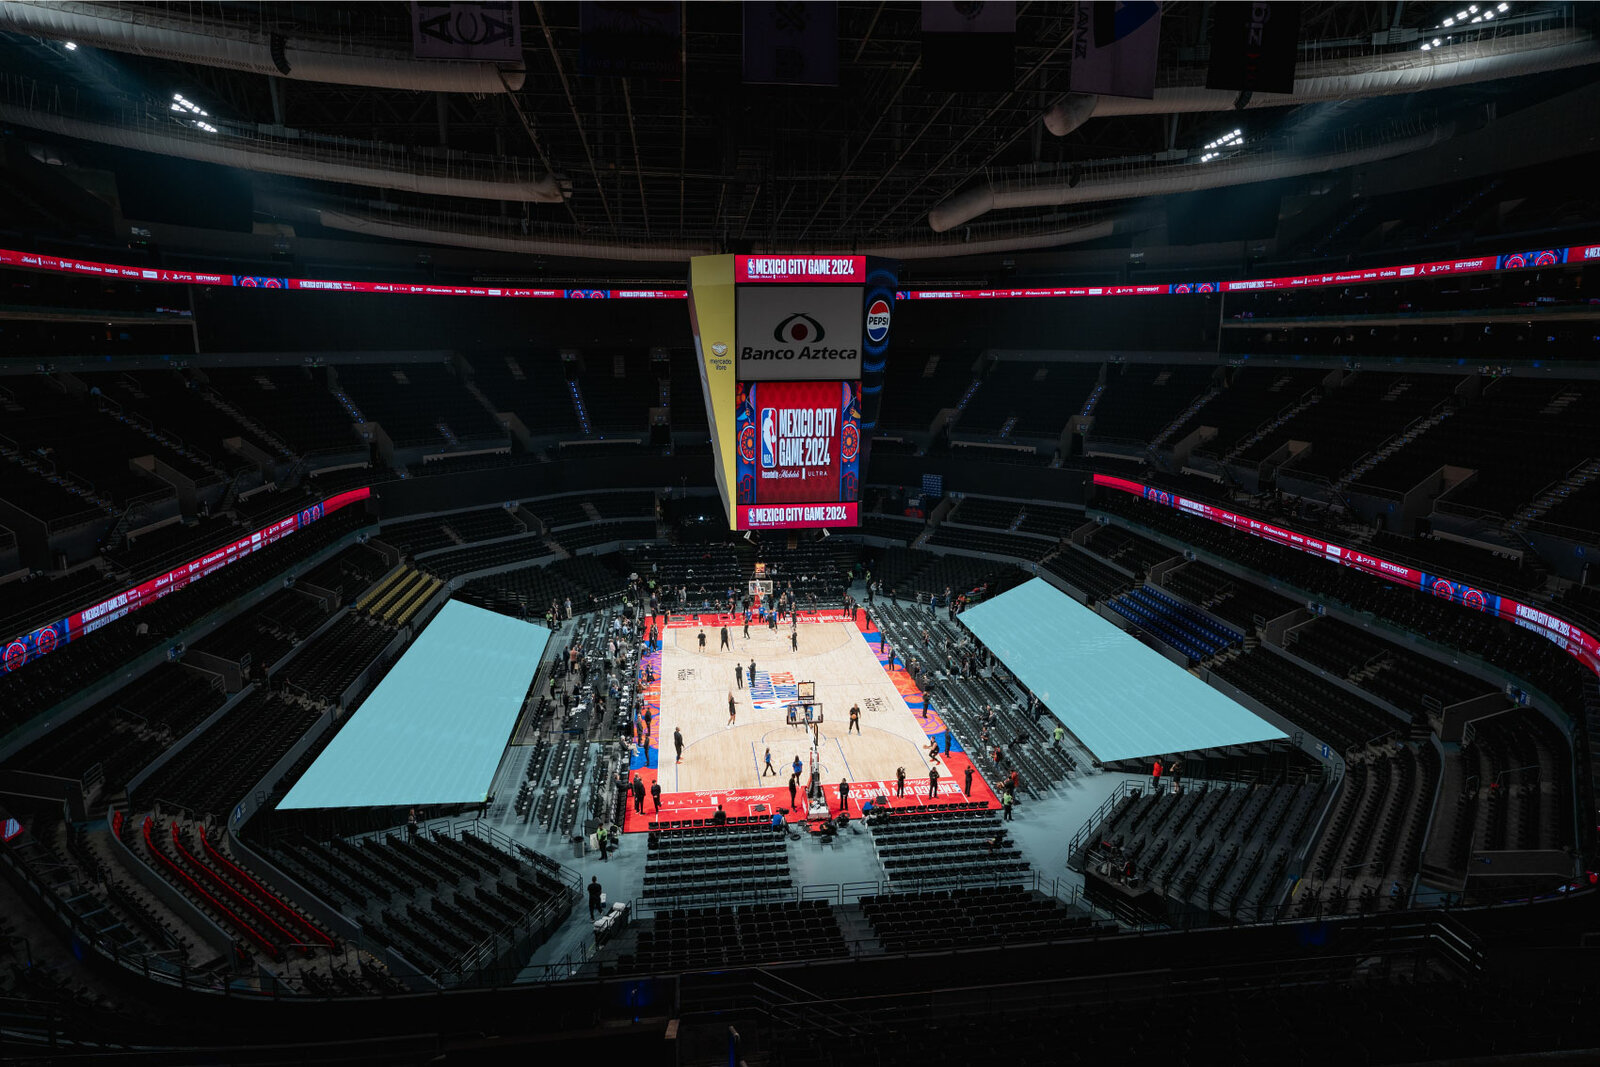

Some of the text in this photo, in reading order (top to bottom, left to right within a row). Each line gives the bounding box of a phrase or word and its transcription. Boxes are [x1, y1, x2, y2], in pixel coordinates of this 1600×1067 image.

[756, 259, 855, 275] MEXICO CITY GAME 2024
[868, 316, 889, 326] PEPSI
[741, 347, 858, 360] Banco Azteca
[779, 408, 838, 438] MEXICO CITY
[779, 437, 831, 467] GAME 2024
[756, 506, 847, 522] MEXICO CITY GAME 2024
[726, 793, 775, 803] Michelob
[833, 784, 951, 800] MEICO CIY GAME 204
